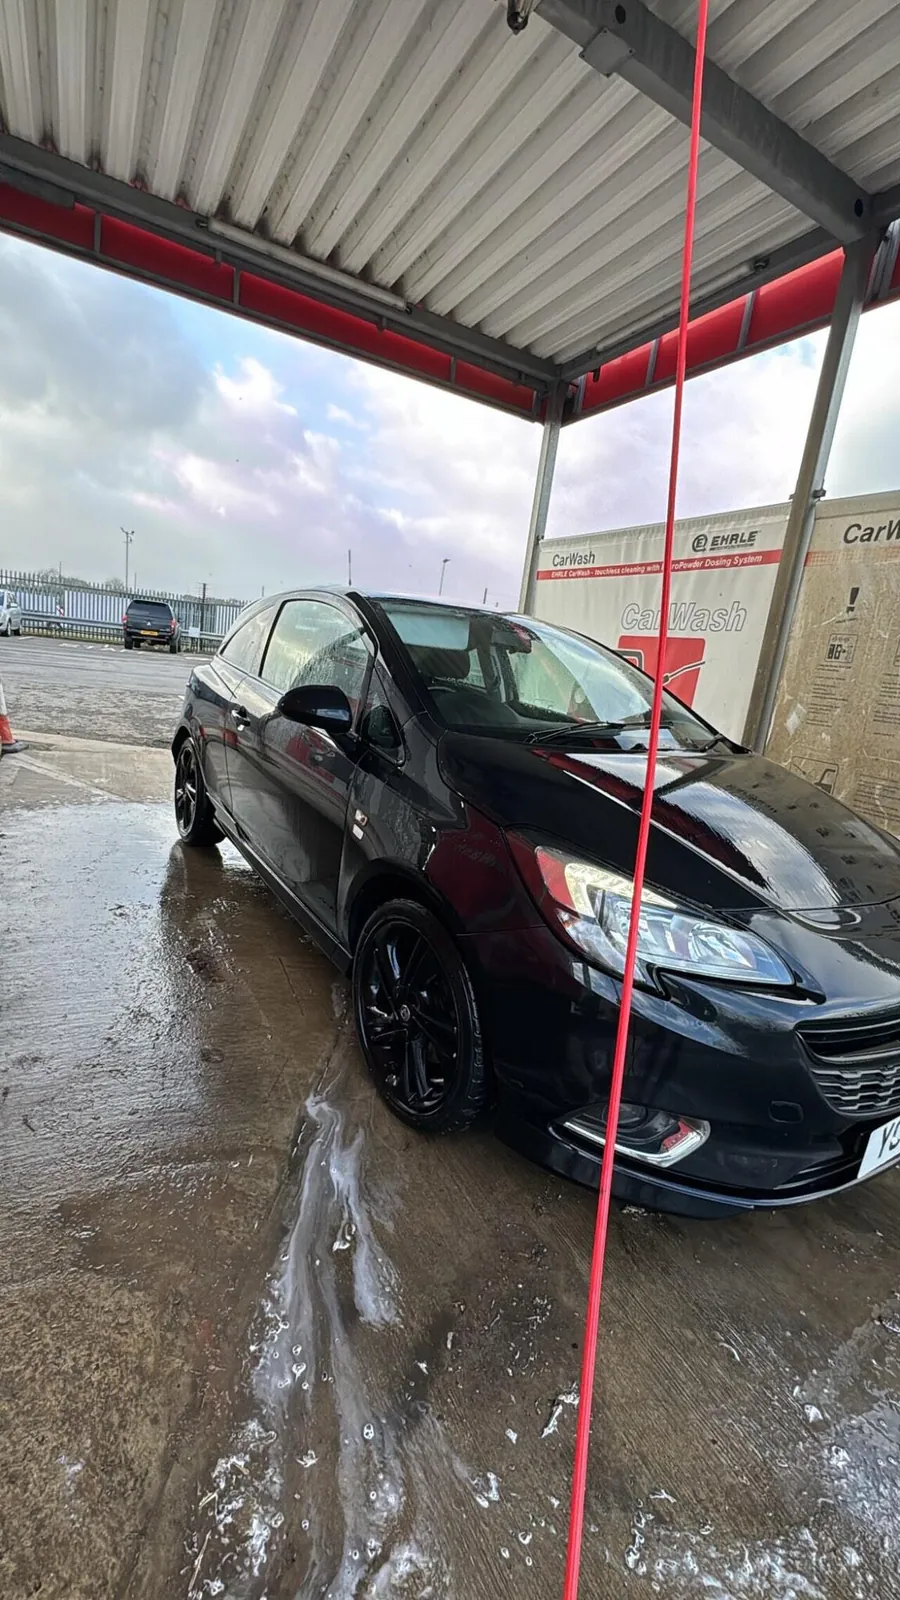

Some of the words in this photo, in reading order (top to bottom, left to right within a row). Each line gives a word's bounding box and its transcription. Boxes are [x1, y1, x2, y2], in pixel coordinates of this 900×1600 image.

[711, 530, 758, 547] EHRLE
[552, 551, 596, 567] CarWash
[594, 568, 620, 576] touchless
[621, 566, 645, 575] cleaning
[646, 564, 660, 572] with
[705, 557, 731, 567] Dosing
[733, 555, 763, 565] System
